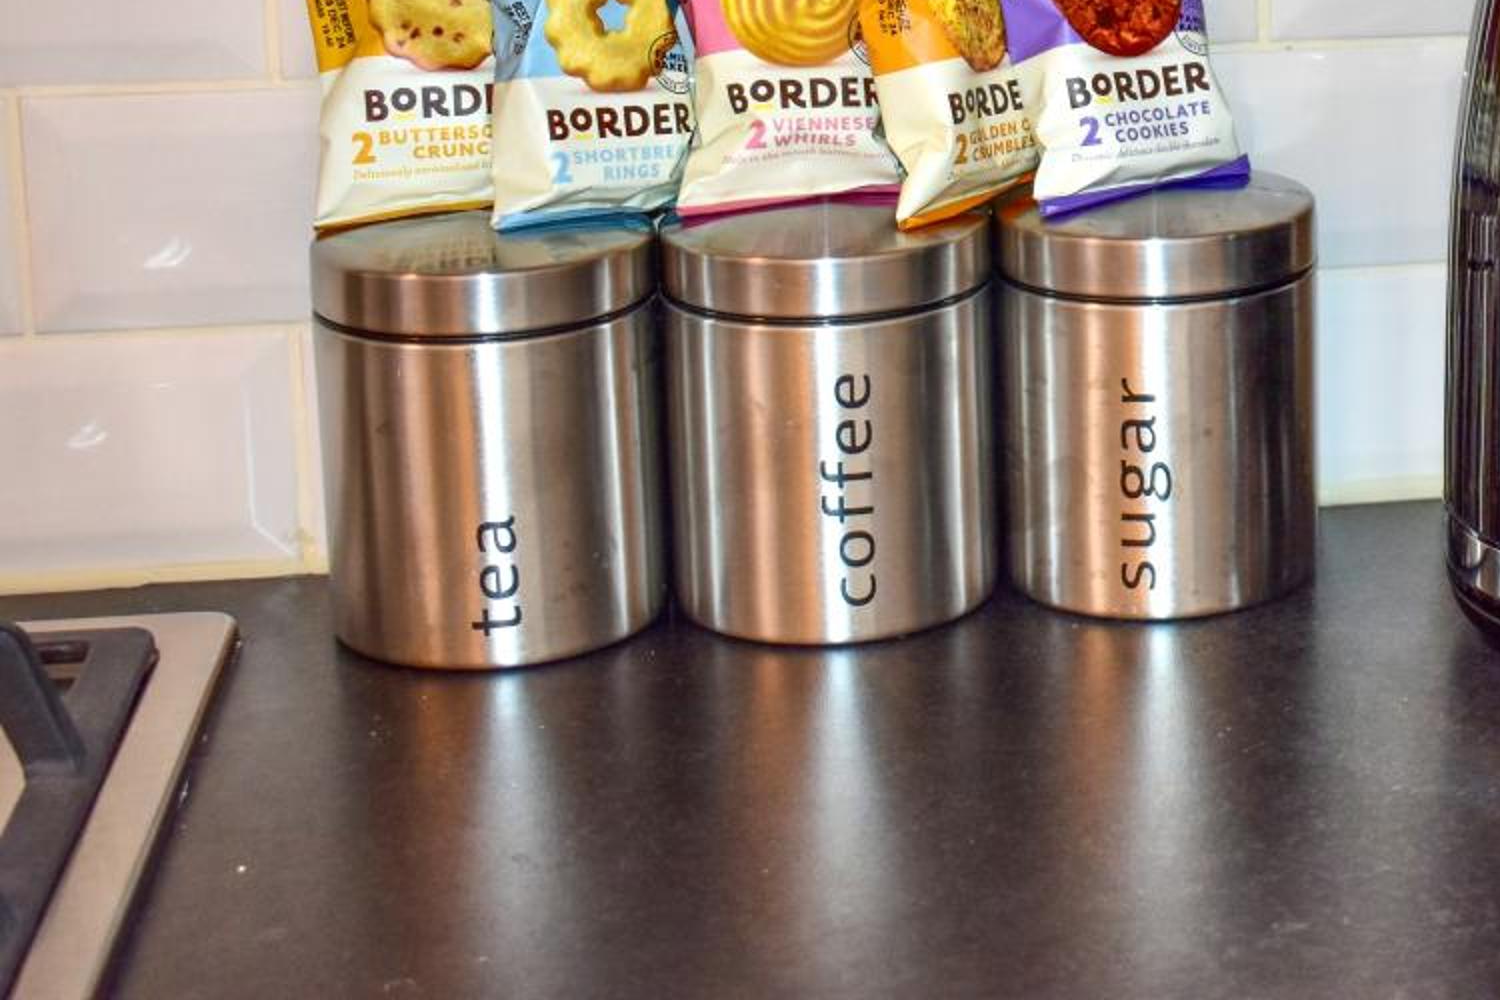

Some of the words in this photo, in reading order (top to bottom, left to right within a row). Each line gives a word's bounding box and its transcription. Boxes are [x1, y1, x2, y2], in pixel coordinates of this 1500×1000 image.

[1065, 61, 1211, 110] BORDER
[546, 103, 694, 140] BORDER
[772, 116, 876, 132] VIENNESE
[1104, 100, 1211, 128] CHOCOLATE
[746, 119, 767, 150] 2
[773, 132, 858, 148] WHIRLS
[1079, 116, 1103, 147] 2
[1114, 121, 1190, 144] COOKIES
[352, 130, 376, 166] 2
[953, 133, 968, 165] 2
[551, 151, 573, 184] 2
[603, 163, 660, 183] RINGS
[819, 373, 878, 607] coffee
[1119, 377, 1174, 591] sugar
[470, 515, 523, 637] tea
